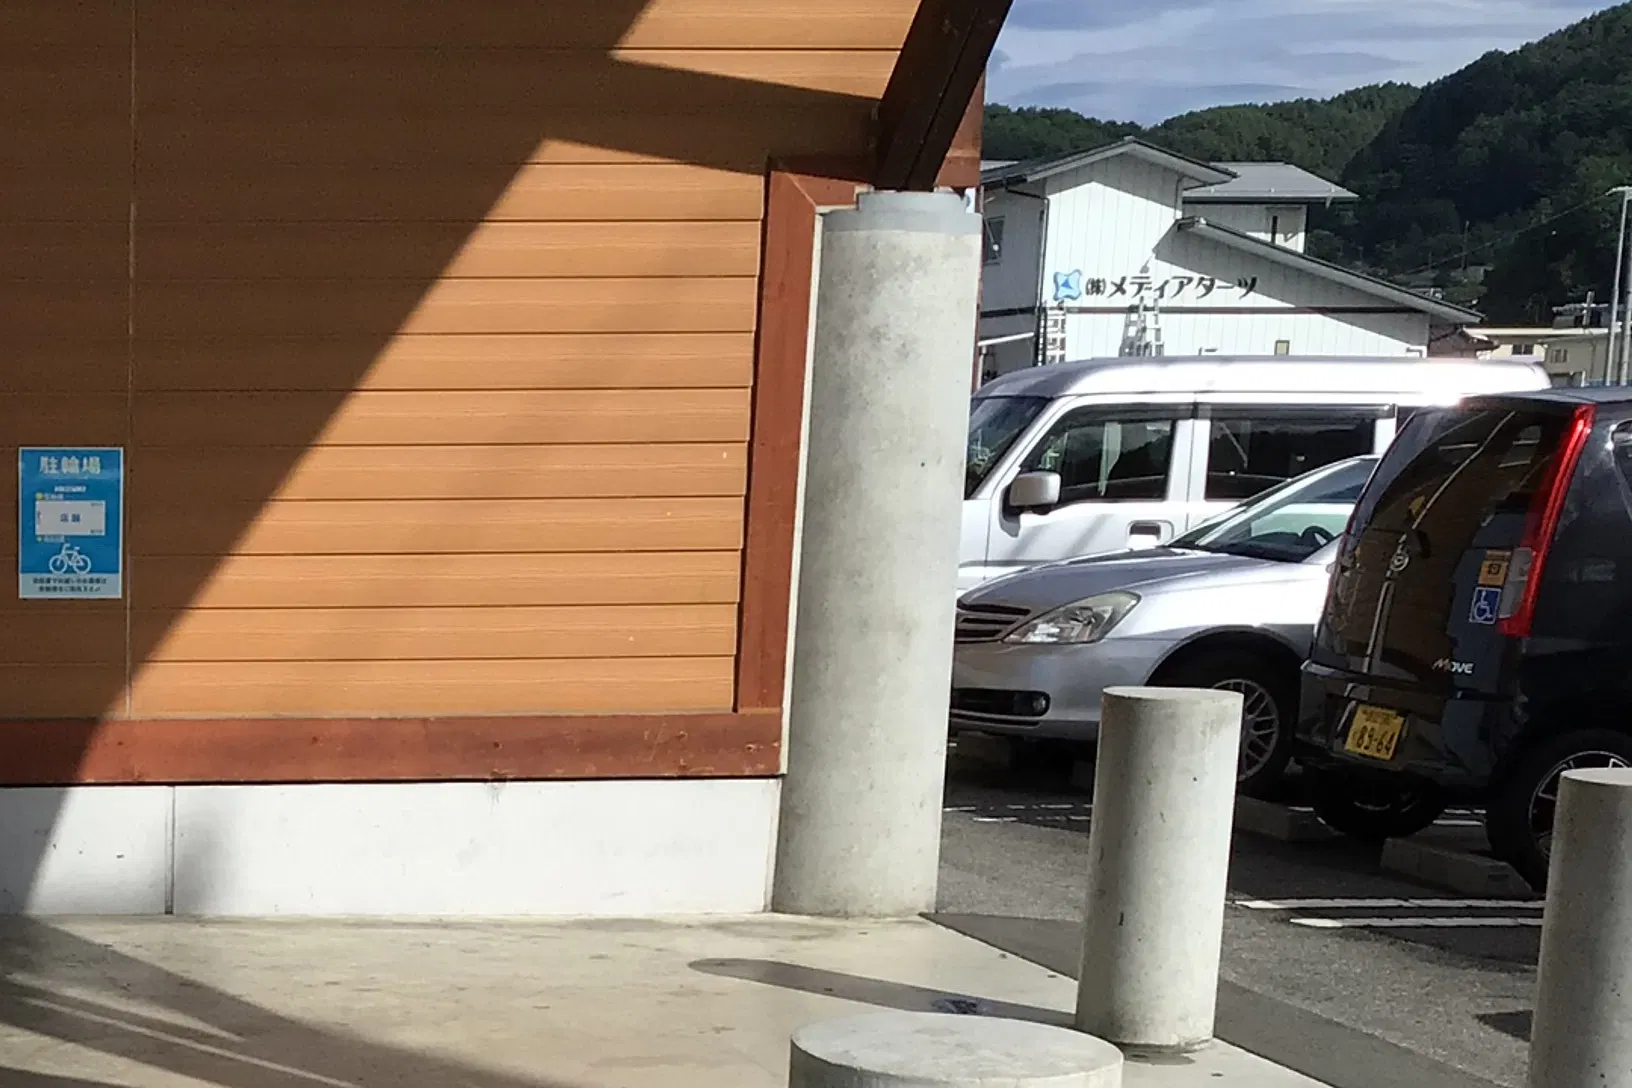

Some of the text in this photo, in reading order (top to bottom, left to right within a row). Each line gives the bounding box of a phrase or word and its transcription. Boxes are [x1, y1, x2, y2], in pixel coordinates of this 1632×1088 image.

[40, 455, 101, 475] 駐輪場
[1431, 657, 1474, 674] MOVE
